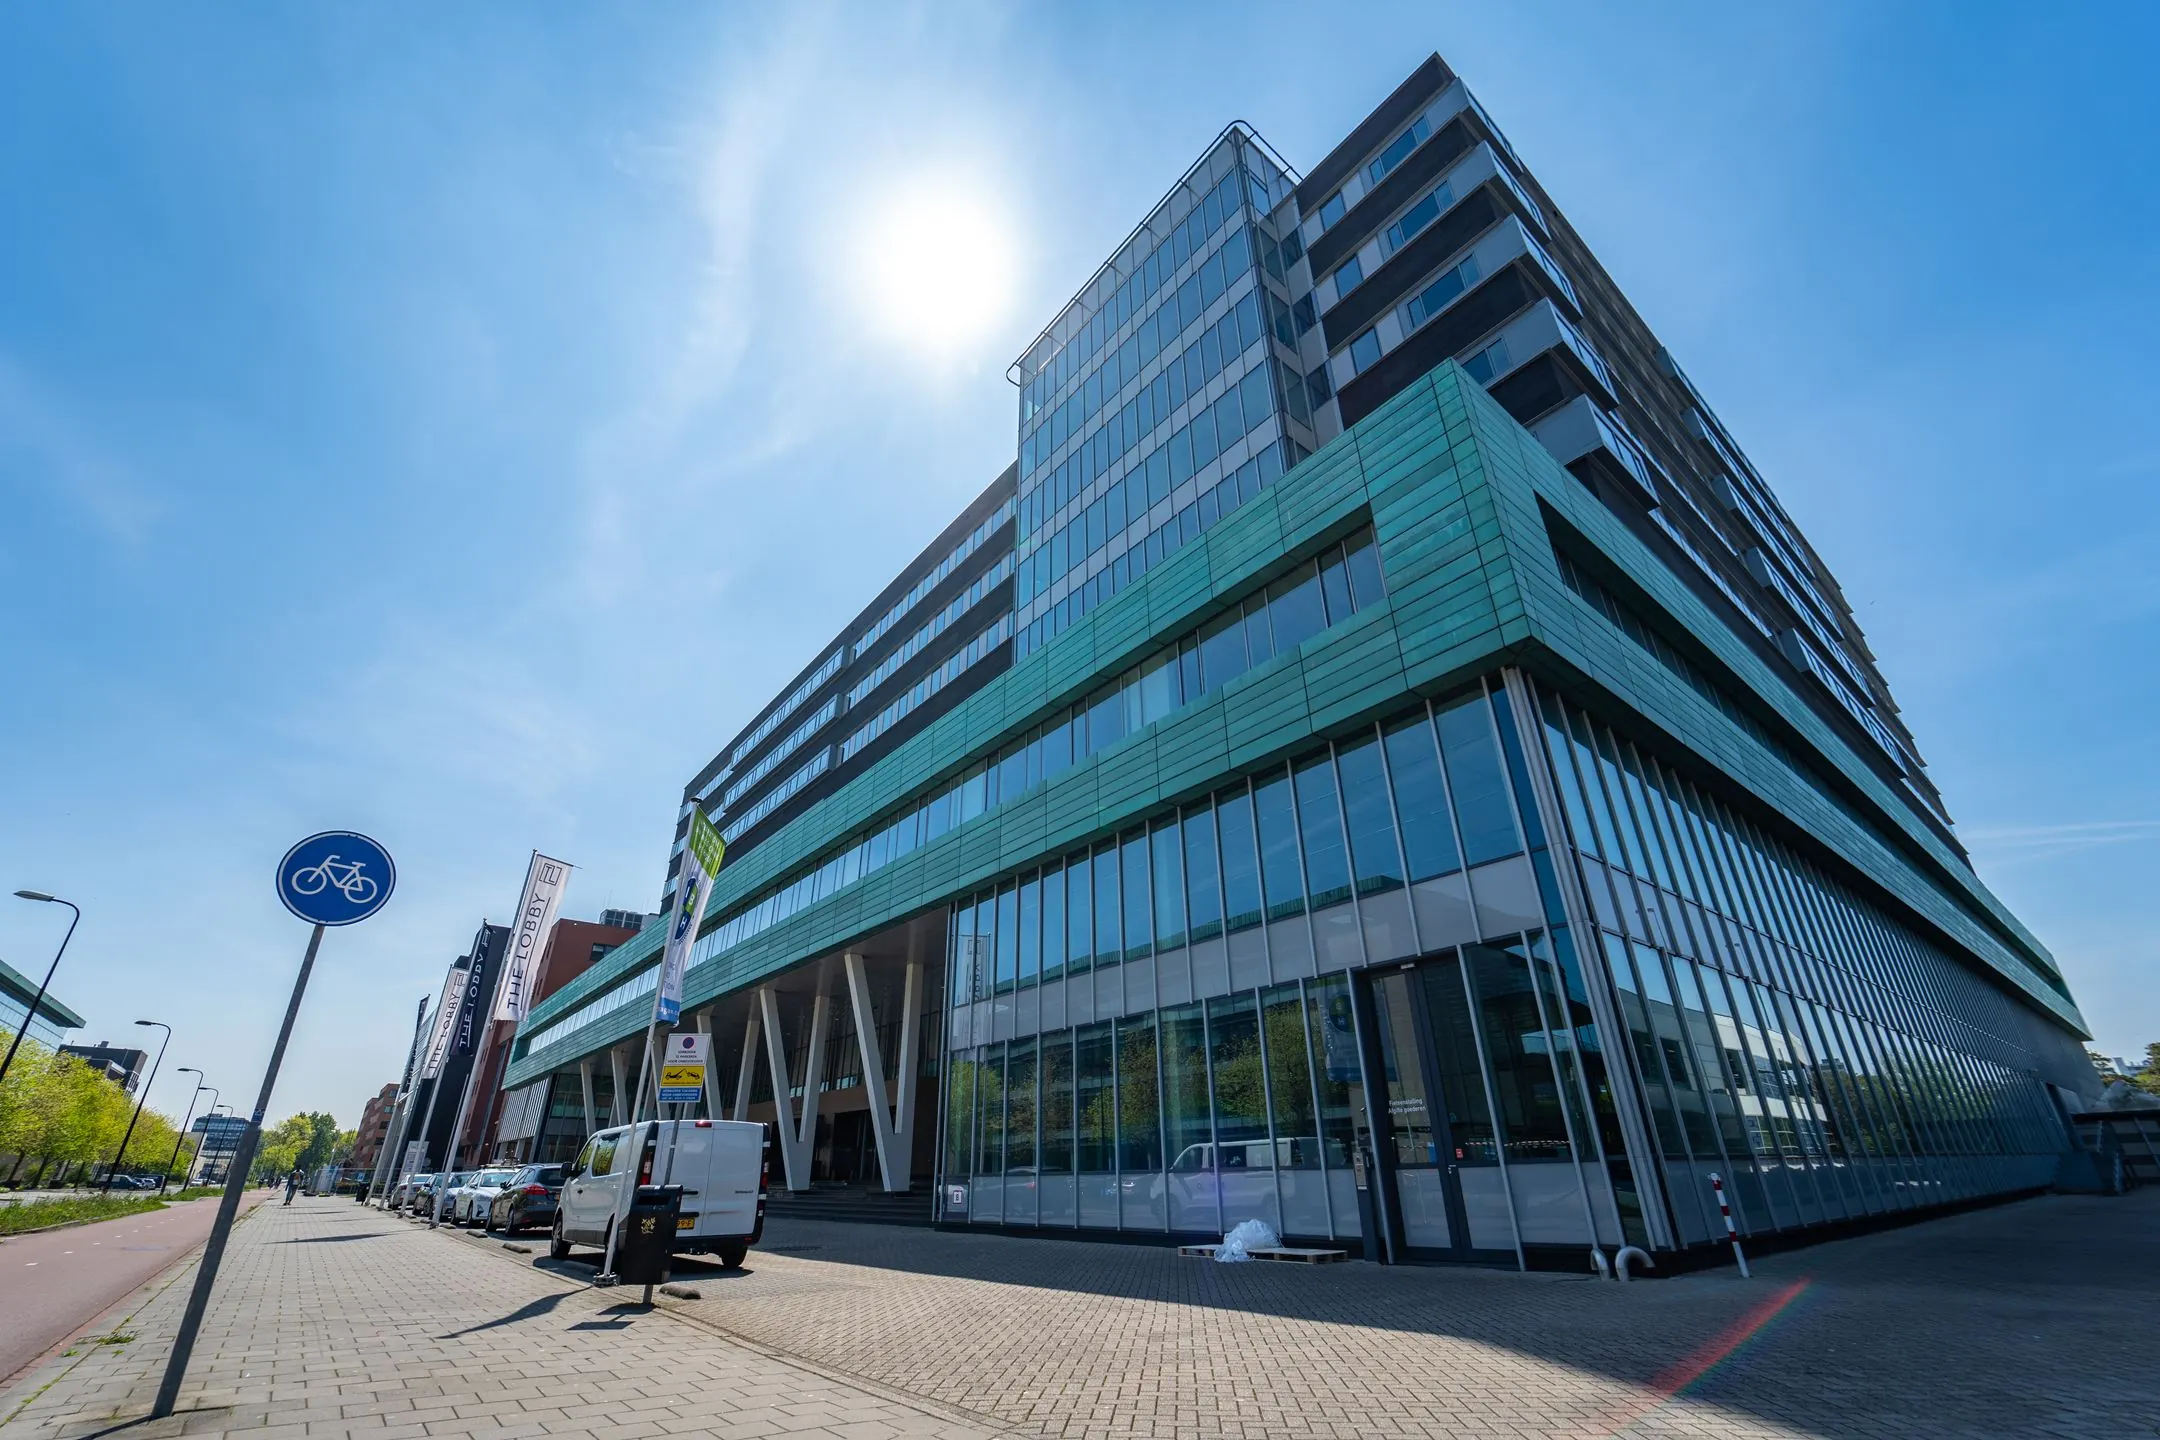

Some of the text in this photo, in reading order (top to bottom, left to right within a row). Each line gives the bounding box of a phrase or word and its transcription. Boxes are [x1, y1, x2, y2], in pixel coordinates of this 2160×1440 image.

[507, 893, 545, 1009] THE LOBBY
[459, 1012, 472, 1048] THE
[428, 1043, 444, 1070] THE
